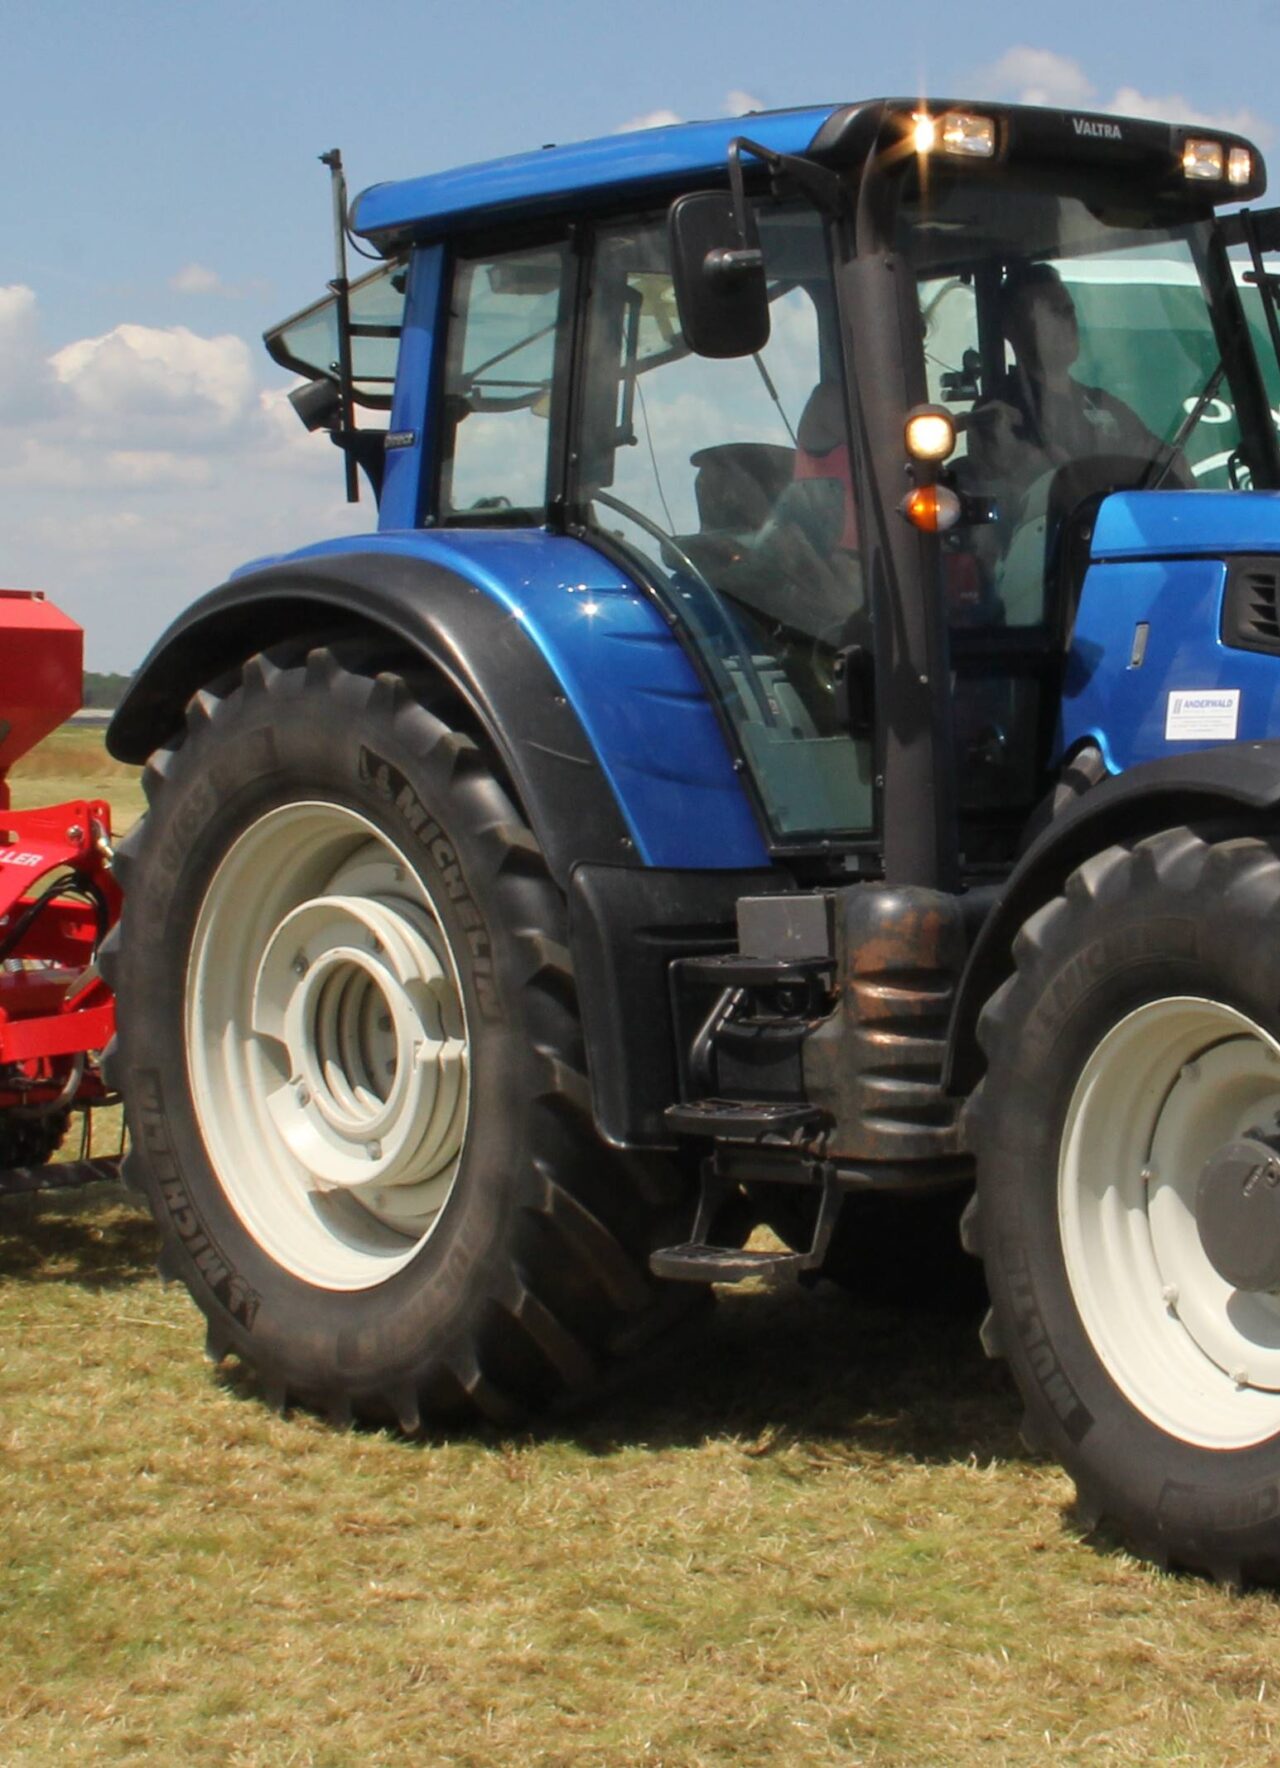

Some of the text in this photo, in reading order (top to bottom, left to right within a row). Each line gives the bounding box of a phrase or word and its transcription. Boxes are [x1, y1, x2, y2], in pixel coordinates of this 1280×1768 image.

[1072, 117, 1122, 139] VALTRA
[1183, 698, 1234, 709] ANDERWALD
[396, 783, 499, 1019] MICHELIN
